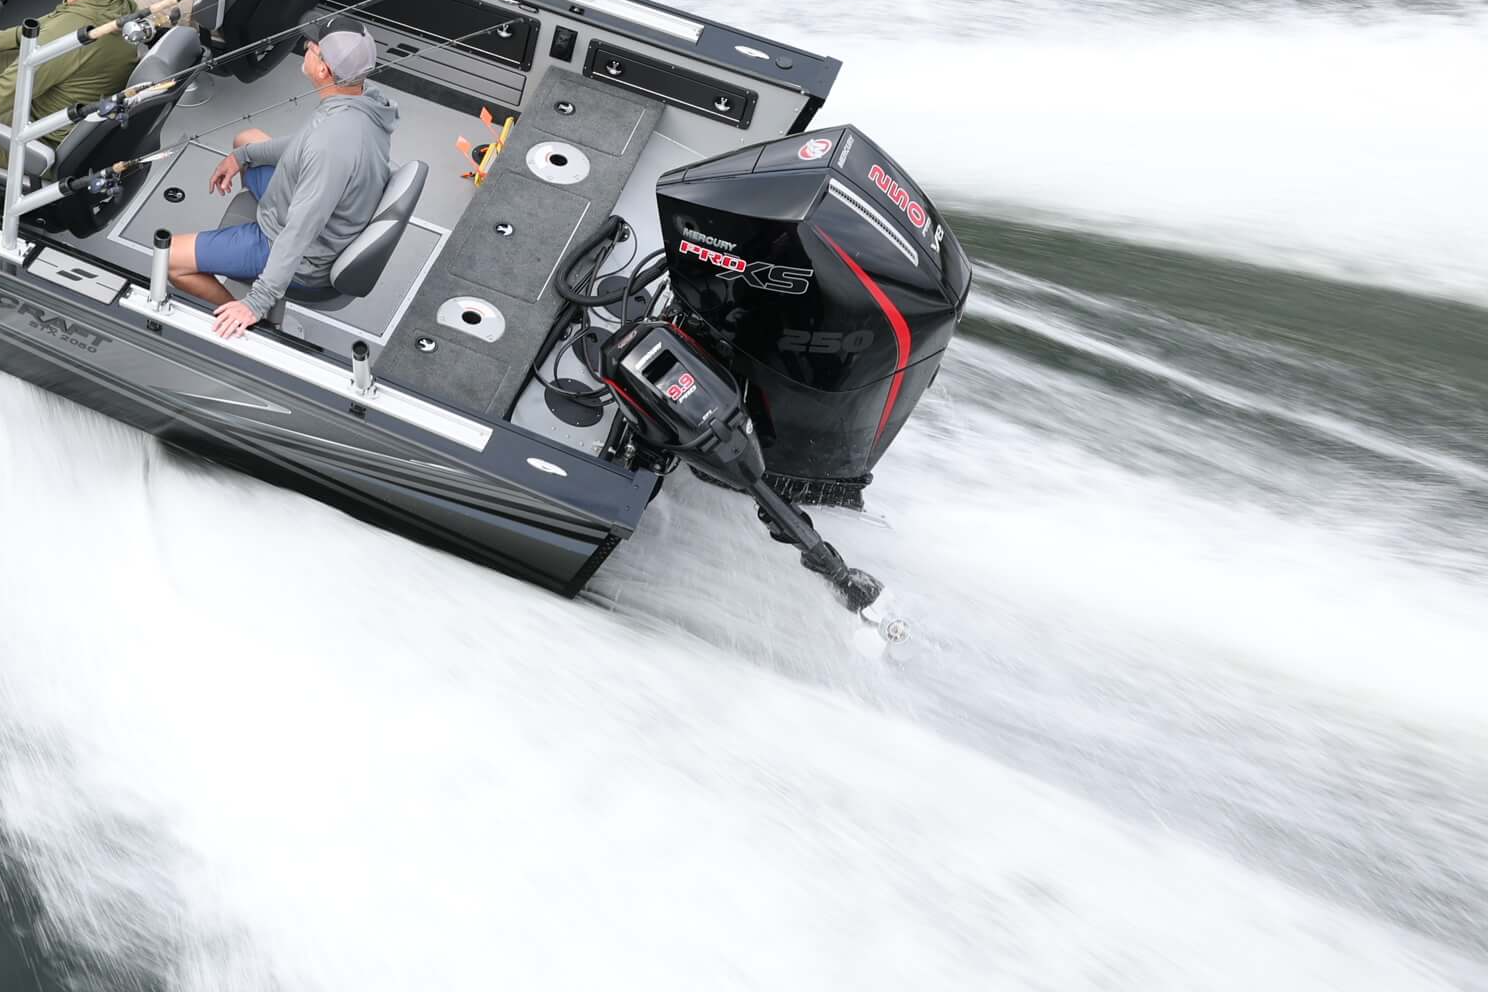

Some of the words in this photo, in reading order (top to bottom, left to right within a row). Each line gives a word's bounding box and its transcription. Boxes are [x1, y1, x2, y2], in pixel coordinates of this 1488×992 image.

[868, 164, 926, 228] 250
[683, 227, 737, 251] MERCURY
[679, 240, 747, 273] PRO
[715, 261, 814, 295] XS
[777, 328, 875, 355] 250
[666, 372, 695, 401] 9.9
